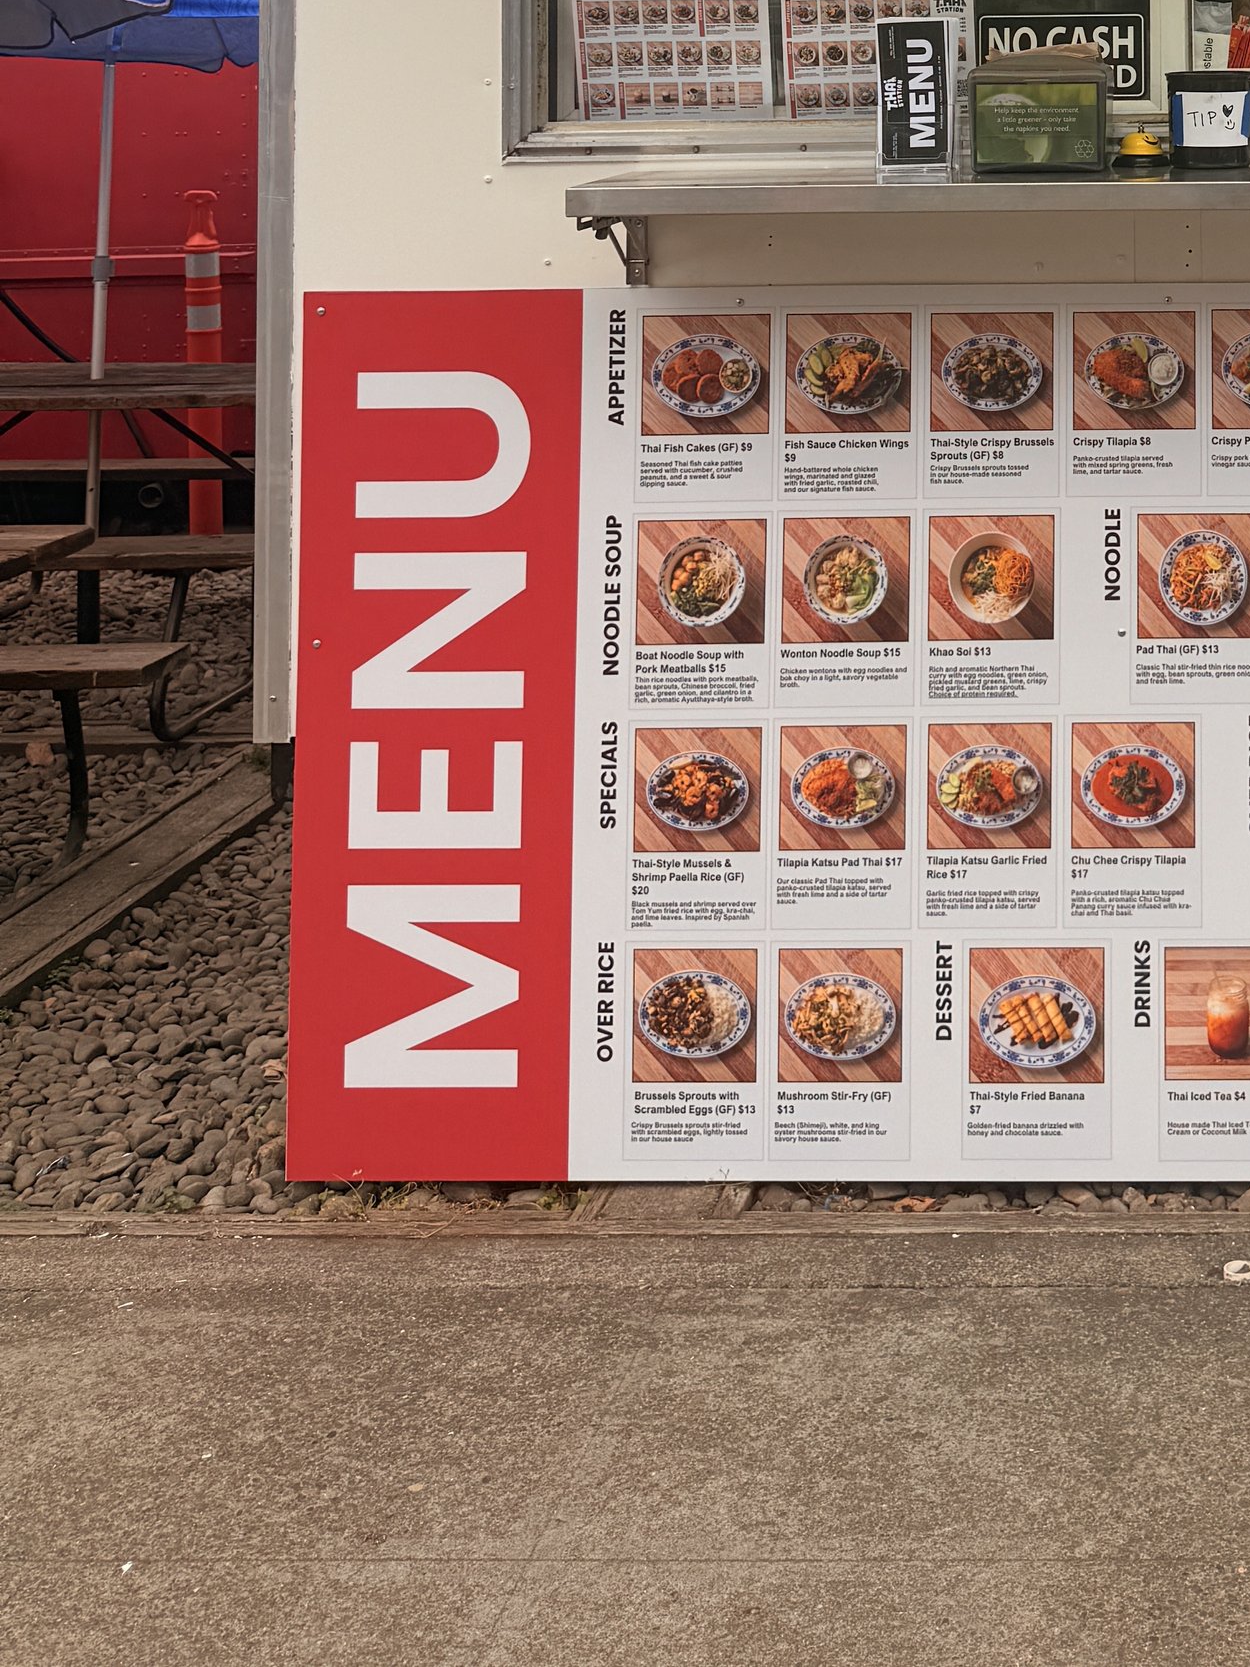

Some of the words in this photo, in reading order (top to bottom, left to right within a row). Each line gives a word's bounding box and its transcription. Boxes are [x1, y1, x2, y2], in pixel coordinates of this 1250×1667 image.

[988, 26, 1039, 52] NO
[1046, 25, 1135, 59] CASH
[905, 38, 937, 149] MENU
[994, 107, 1009, 115] Help
[1011, 107, 1026, 115] keep
[1186, 110, 1217, 128] TIP
[1015, 125, 1040, 134] napkins
[608, 310, 625, 425] APPETIZER
[639, 444, 662, 452] Thai
[663, 444, 684, 452] Fish
[685, 443, 716, 452] Cakes
[717, 443, 739, 453] (GF)
[740, 442, 753, 451] $9
[929, 438, 979, 449] Thai-Style
[980, 438, 1012, 448] Crispy
[1013, 437, 1055, 446] Brussels
[1072, 437, 1104, 447] Crispy
[1105, 437, 1138, 447] Tilapia
[1138, 436, 1152, 445] $8
[929, 451, 968, 461] Sprouts
[969, 451, 991, 461] (GF)
[991, 450, 1004, 459] $8
[604, 515, 623, 577] SOUP
[1105, 509, 1120, 600] NOODLE
[602, 582, 621, 676] NOODLE
[928, 647, 954, 656] Khao
[955, 647, 972, 656] Soi
[973, 647, 992, 656] $13
[343, 370, 532, 1089] MENU
[600, 722, 617, 828] SPECIALS
[631, 859, 681, 870] Thai-Style
[682, 859, 723, 867] Mussels
[723, 858, 732, 867] &
[1070, 855, 1091, 864] Chu
[1092, 855, 1119, 864] Chee
[1119, 855, 1153, 866] Crispy
[1153, 855, 1187, 866] Tilapia
[631, 872, 667, 883] Shrimp
[668, 872, 698, 881] Paella
[699, 872, 722, 881] Rice
[723, 872, 745, 882] (GF)
[1070, 869, 1089, 878] $17
[631, 885, 650, 895] $20
[597, 941, 615, 993] RICE
[1135, 941, 1150, 1027] DRINKS
[936, 941, 952, 1040] DESSERT
[596, 999, 614, 1063] OVER
[968, 1091, 1019, 1102] Thai-Style
[1020, 1091, 1046, 1100] Fried
[1048, 1091, 1085, 1100] Banana
[1166, 1091, 1188, 1100] Thai
[1190, 1091, 1212, 1100] Iced
[1213, 1091, 1232, 1100] Tea
[1233, 1091, 1246, 1100] $4
[968, 1104, 982, 1114] $7
